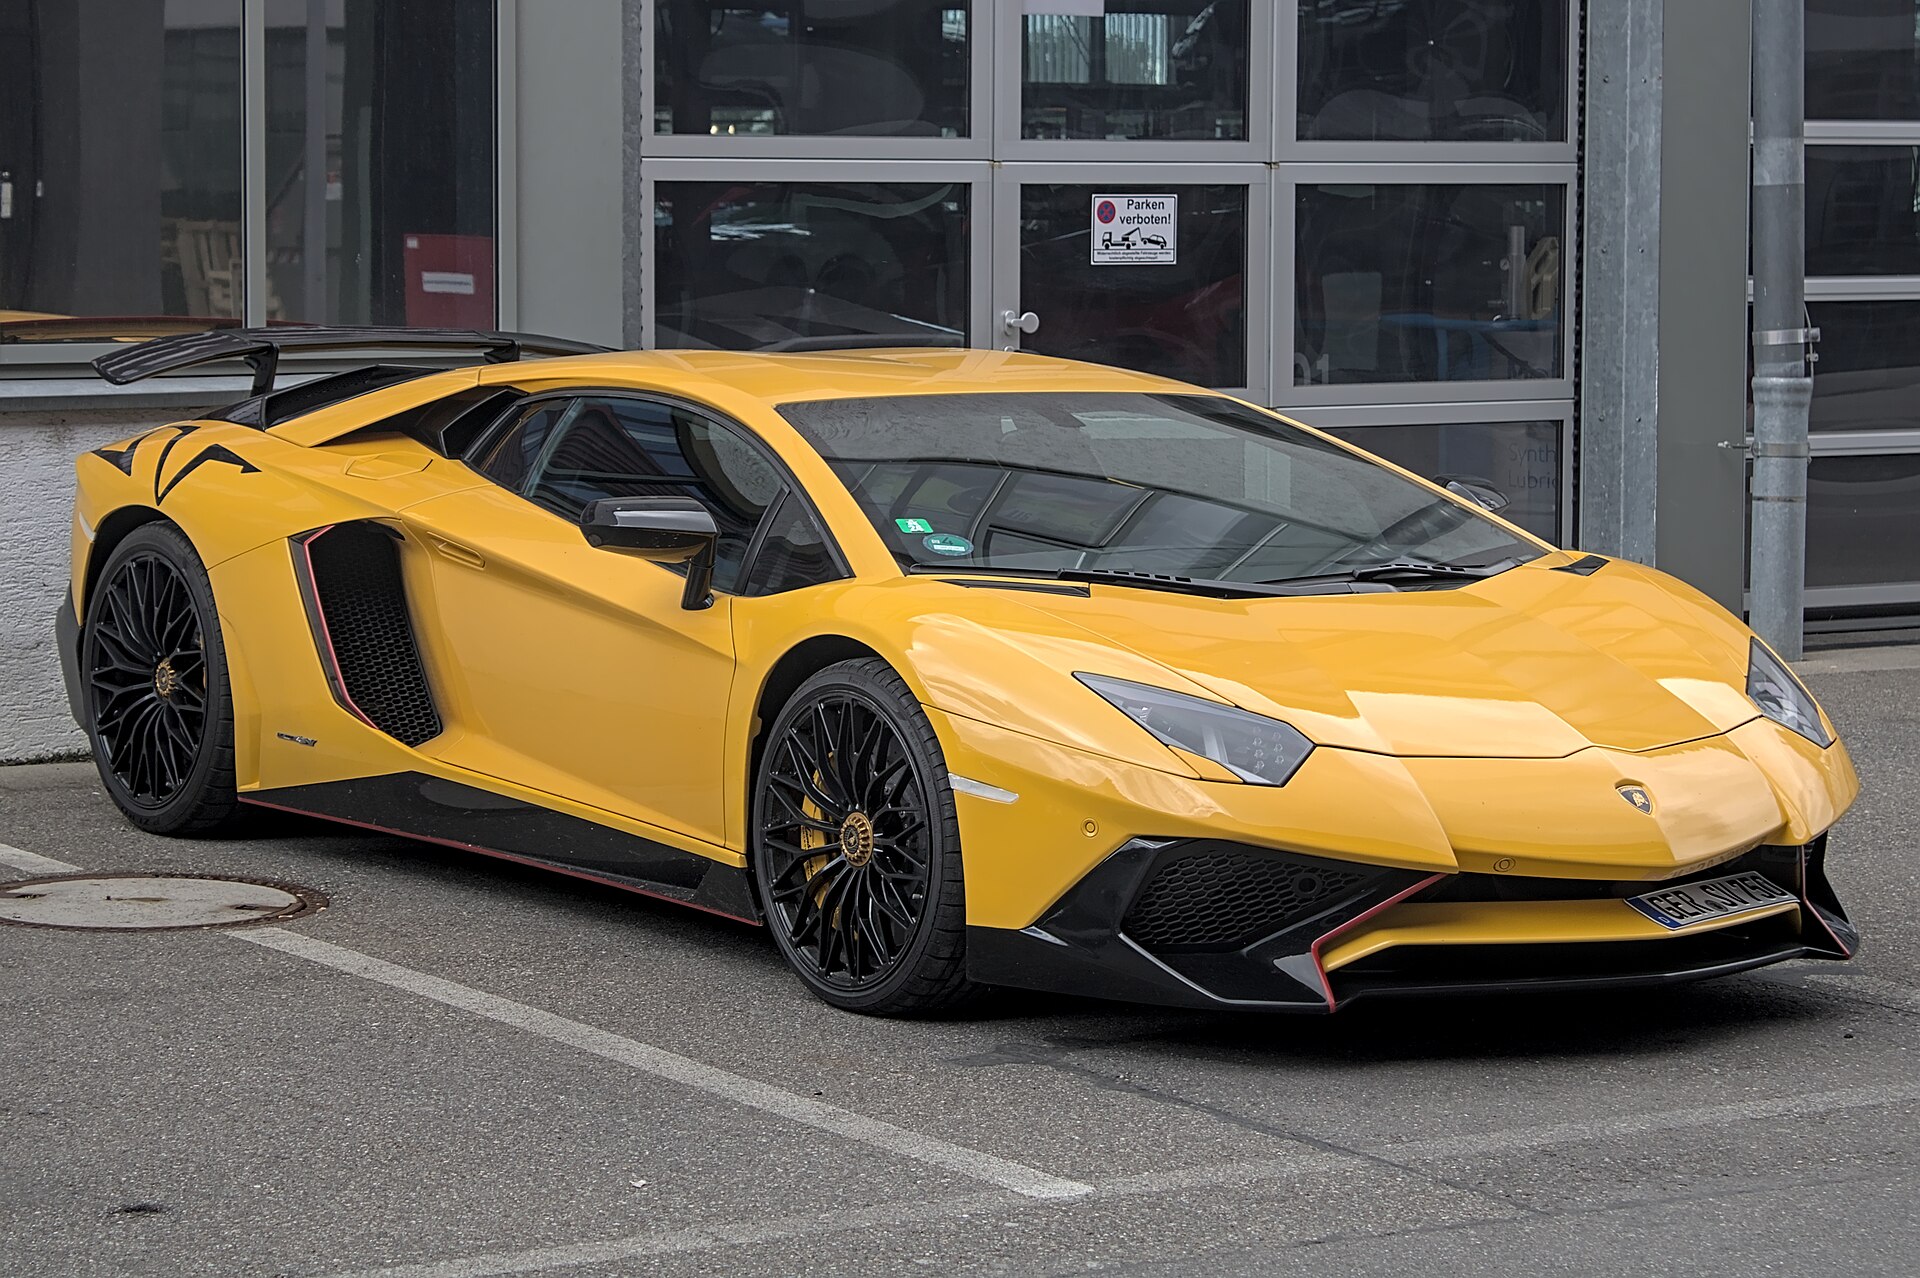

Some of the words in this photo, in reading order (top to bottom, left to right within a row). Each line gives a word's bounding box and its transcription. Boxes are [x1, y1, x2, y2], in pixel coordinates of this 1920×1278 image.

[1127, 199, 1165, 210] Parken
[1120, 213, 1171, 225] verboten!
[1646, 890, 1714, 920] GER
